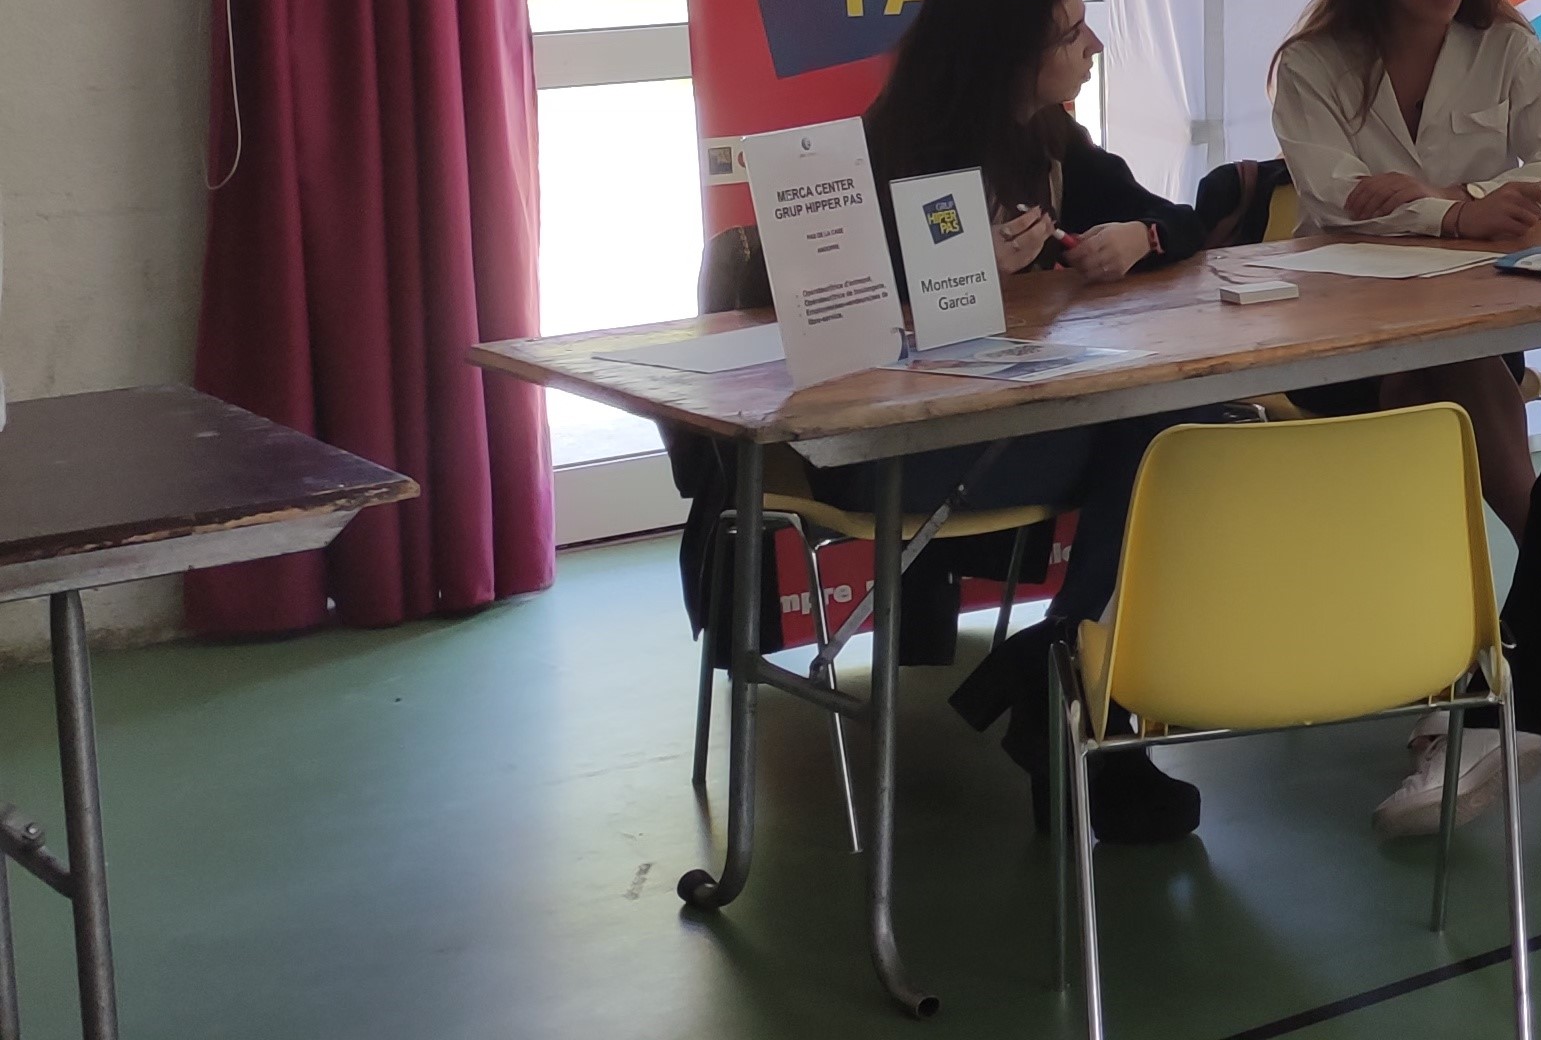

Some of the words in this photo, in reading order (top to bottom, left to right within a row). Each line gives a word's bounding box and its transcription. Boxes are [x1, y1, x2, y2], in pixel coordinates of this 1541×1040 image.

[777, 185, 814, 203] MERCA
[814, 178, 855, 196] CENTER
[774, 204, 803, 220] GRUP
[805, 197, 842, 214] HIPPER
[842, 192, 863, 207] PAS
[927, 209, 957, 225] HIPER
[940, 220, 960, 235] PAS
[921, 270, 987, 294] Montserrat
